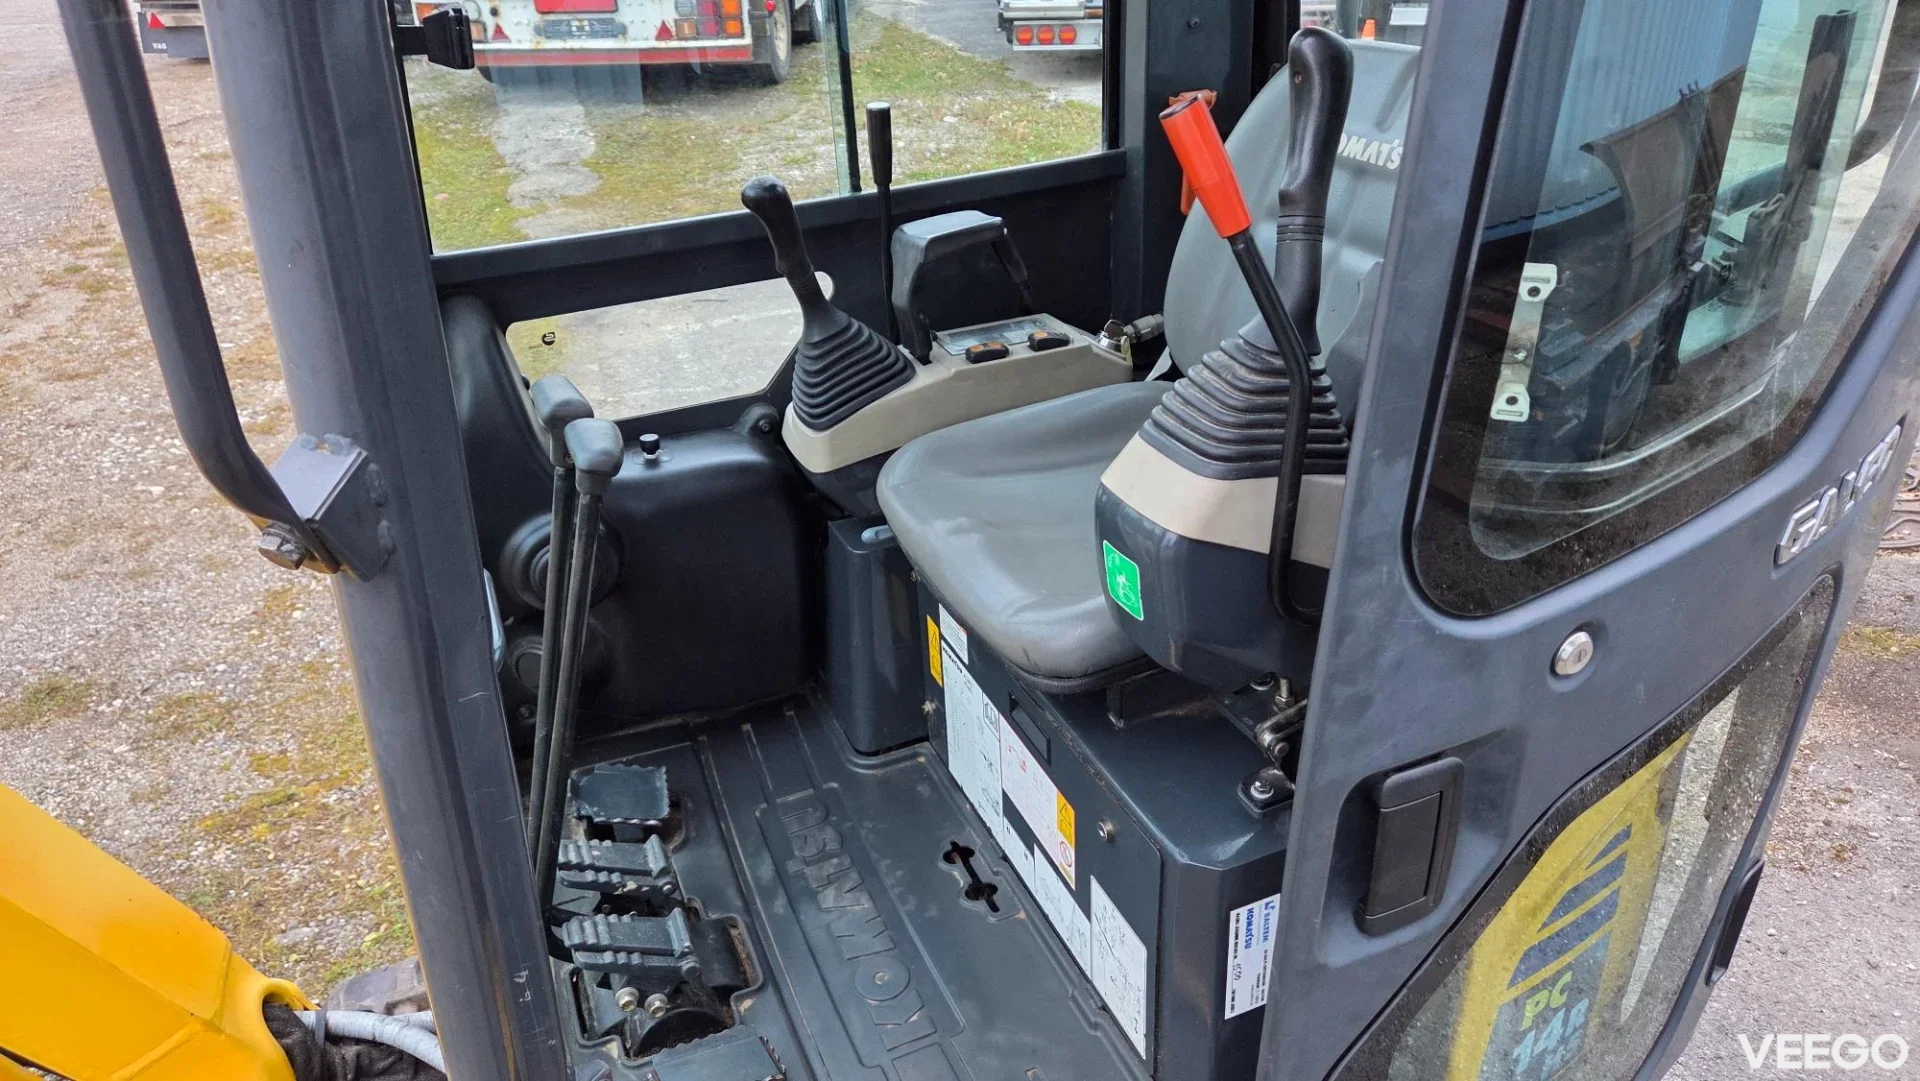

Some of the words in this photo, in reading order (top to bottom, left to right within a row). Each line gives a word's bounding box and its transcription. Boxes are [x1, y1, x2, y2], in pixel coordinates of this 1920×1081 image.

[777, 788, 938, 1051] KOMATSU
[1244, 907, 1255, 949] KOMATSU
[1521, 971, 1573, 1030] PC
